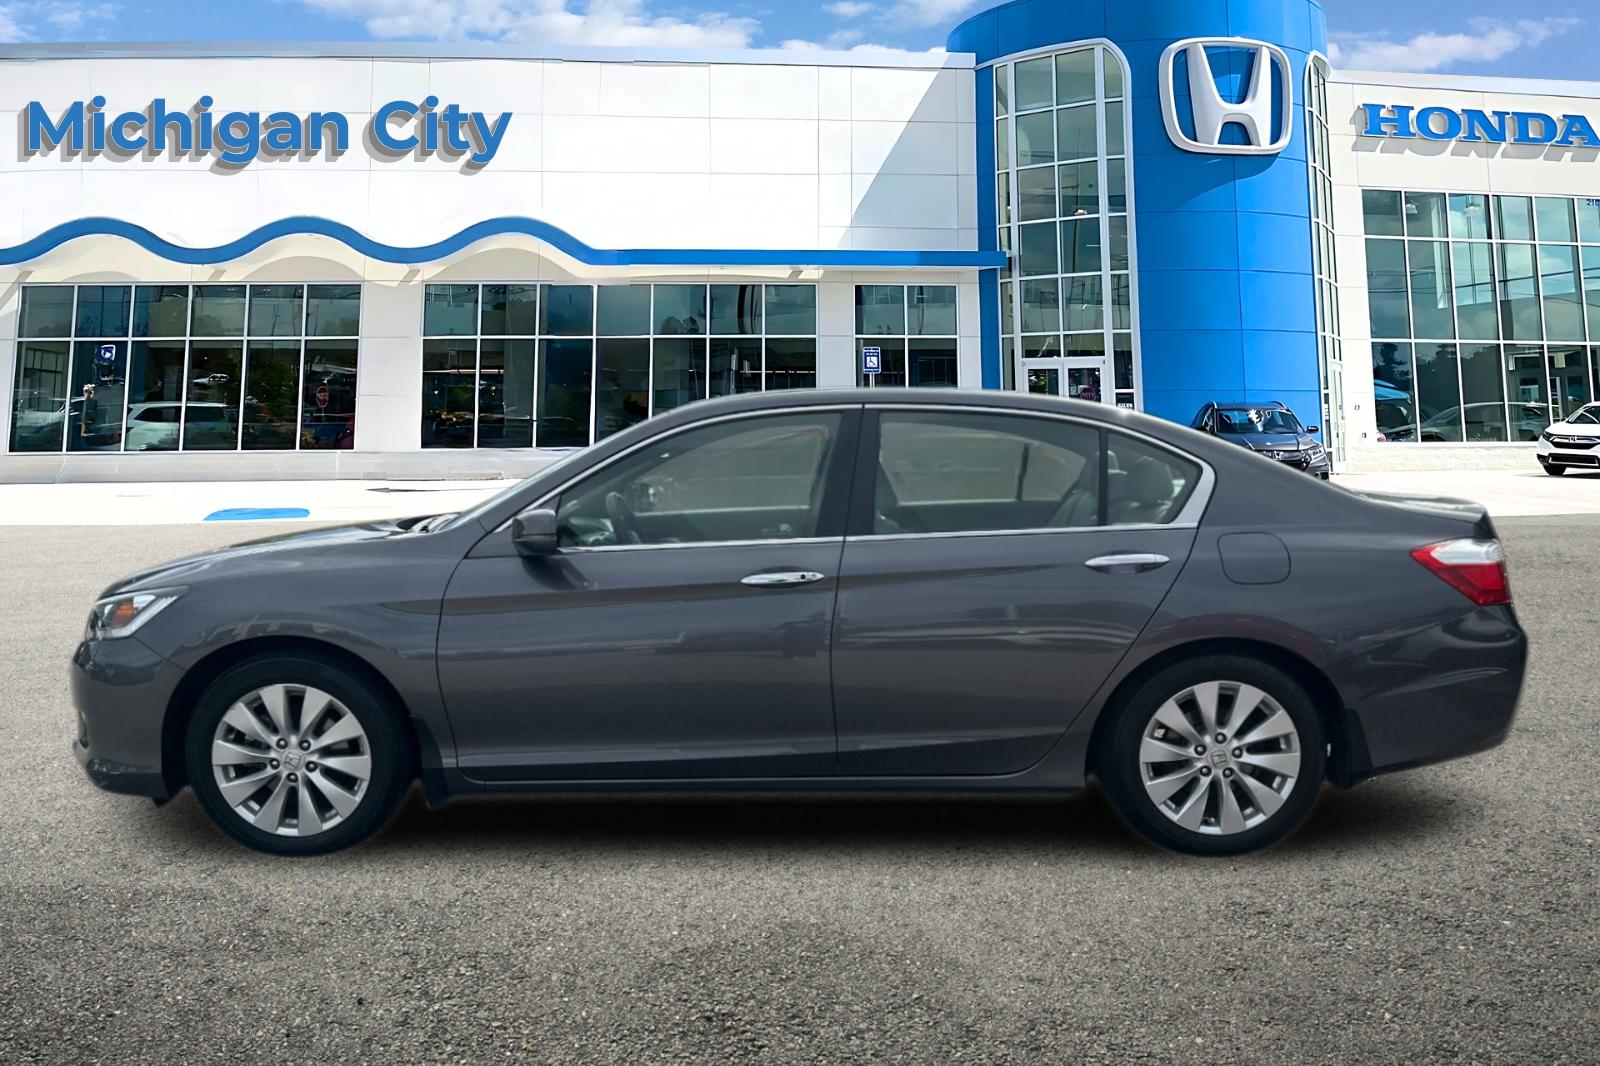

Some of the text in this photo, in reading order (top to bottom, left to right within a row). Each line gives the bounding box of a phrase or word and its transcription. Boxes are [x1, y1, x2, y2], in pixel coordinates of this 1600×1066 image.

[28, 95, 514, 164] Michigan City
[1361, 103, 1600, 147] HONDA
